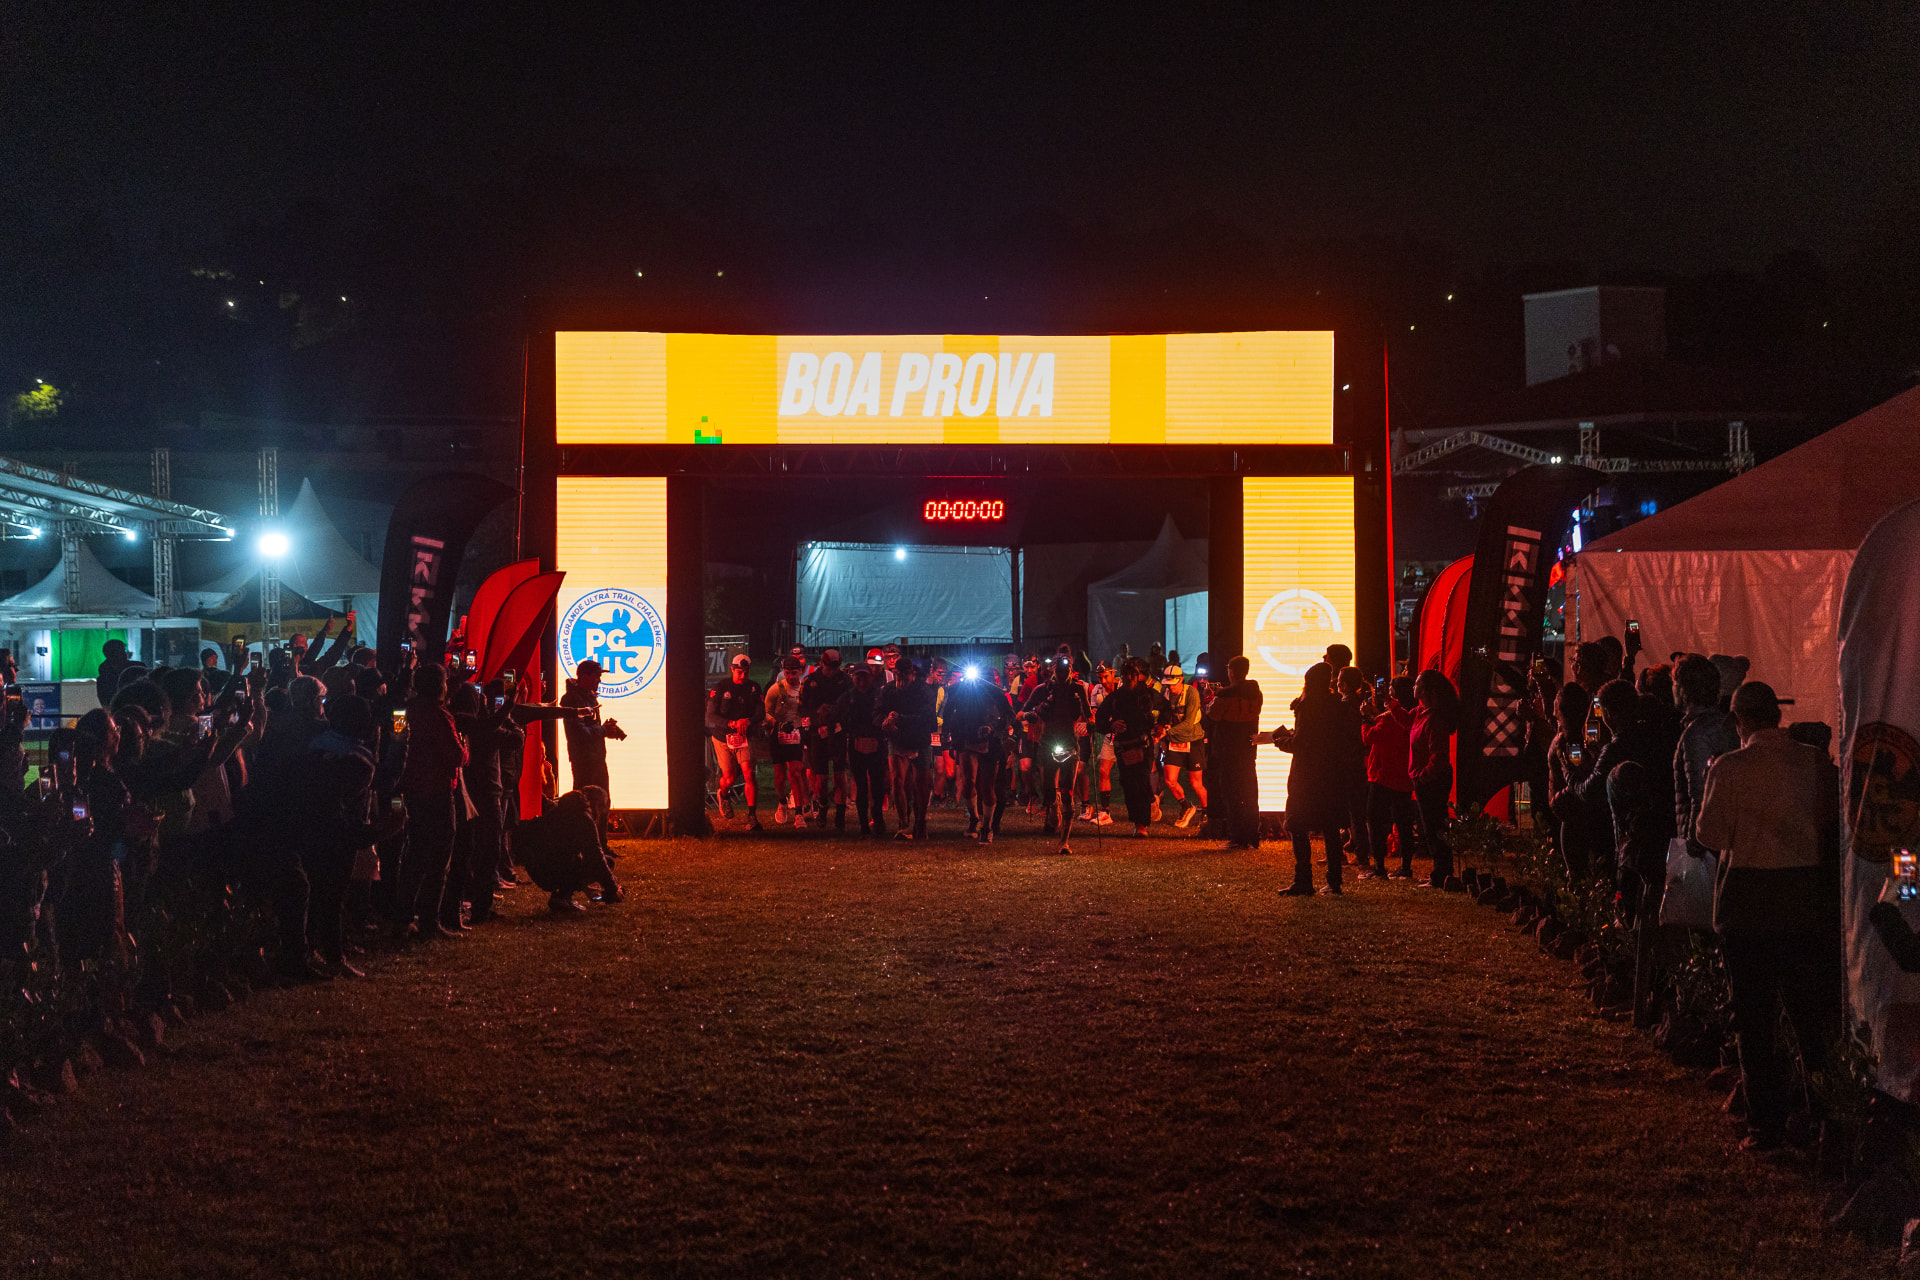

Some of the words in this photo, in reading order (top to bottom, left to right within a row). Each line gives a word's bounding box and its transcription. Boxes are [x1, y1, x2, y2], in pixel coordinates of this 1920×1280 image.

[779, 352, 882, 416] BOA
[889, 352, 1055, 417] PROVA
[924, 501, 1003, 519] 00:00:00
[584, 593, 610, 606] ULTRA
[612, 593, 634, 604] TRAIL
[564, 604, 584, 636] GRANDE
[636, 602, 662, 648] CHALLENGE
[563, 638, 574, 666] PEDRA
[586, 628, 627, 657] PG
[708, 651, 726, 674] 7K
[634, 676, 643, 686] SP
